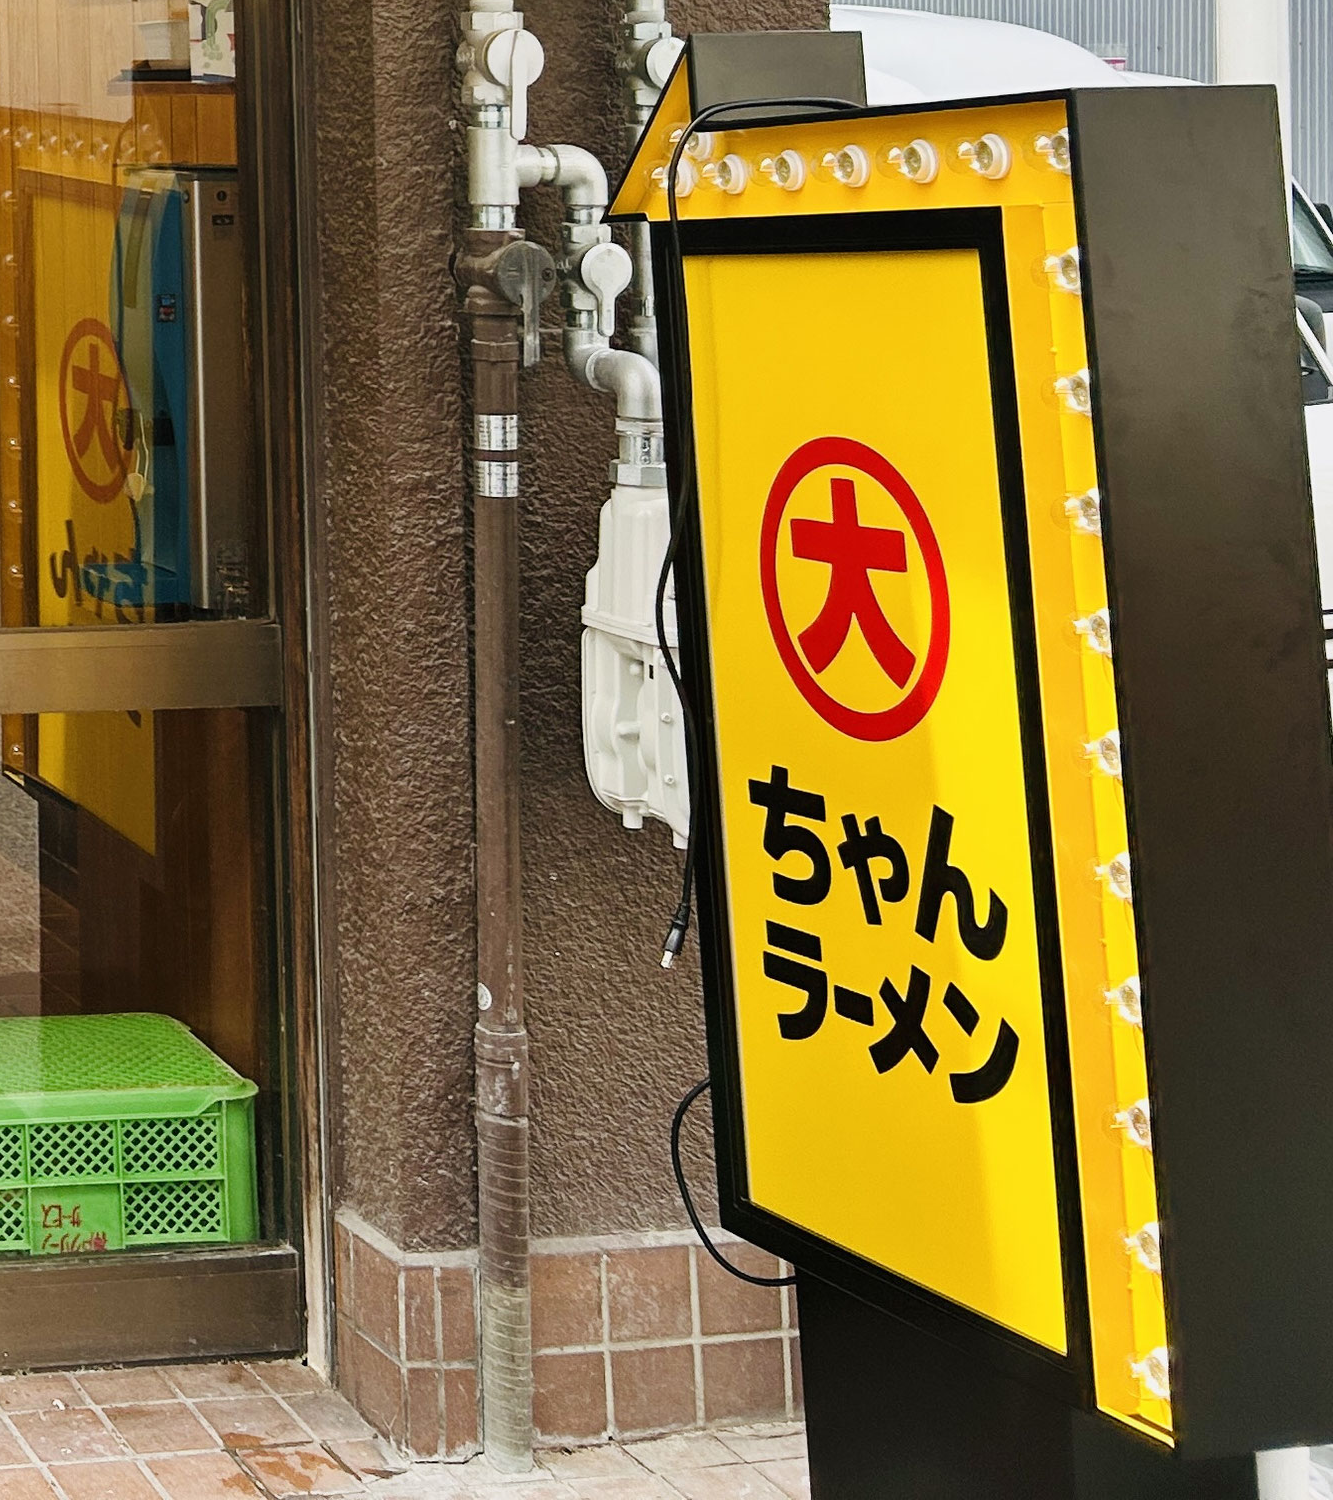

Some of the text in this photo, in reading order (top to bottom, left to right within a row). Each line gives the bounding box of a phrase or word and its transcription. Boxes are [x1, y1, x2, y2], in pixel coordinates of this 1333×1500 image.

[748, 764, 1009, 962] ちゃん
[763, 919, 1021, 1105] ラーメン
